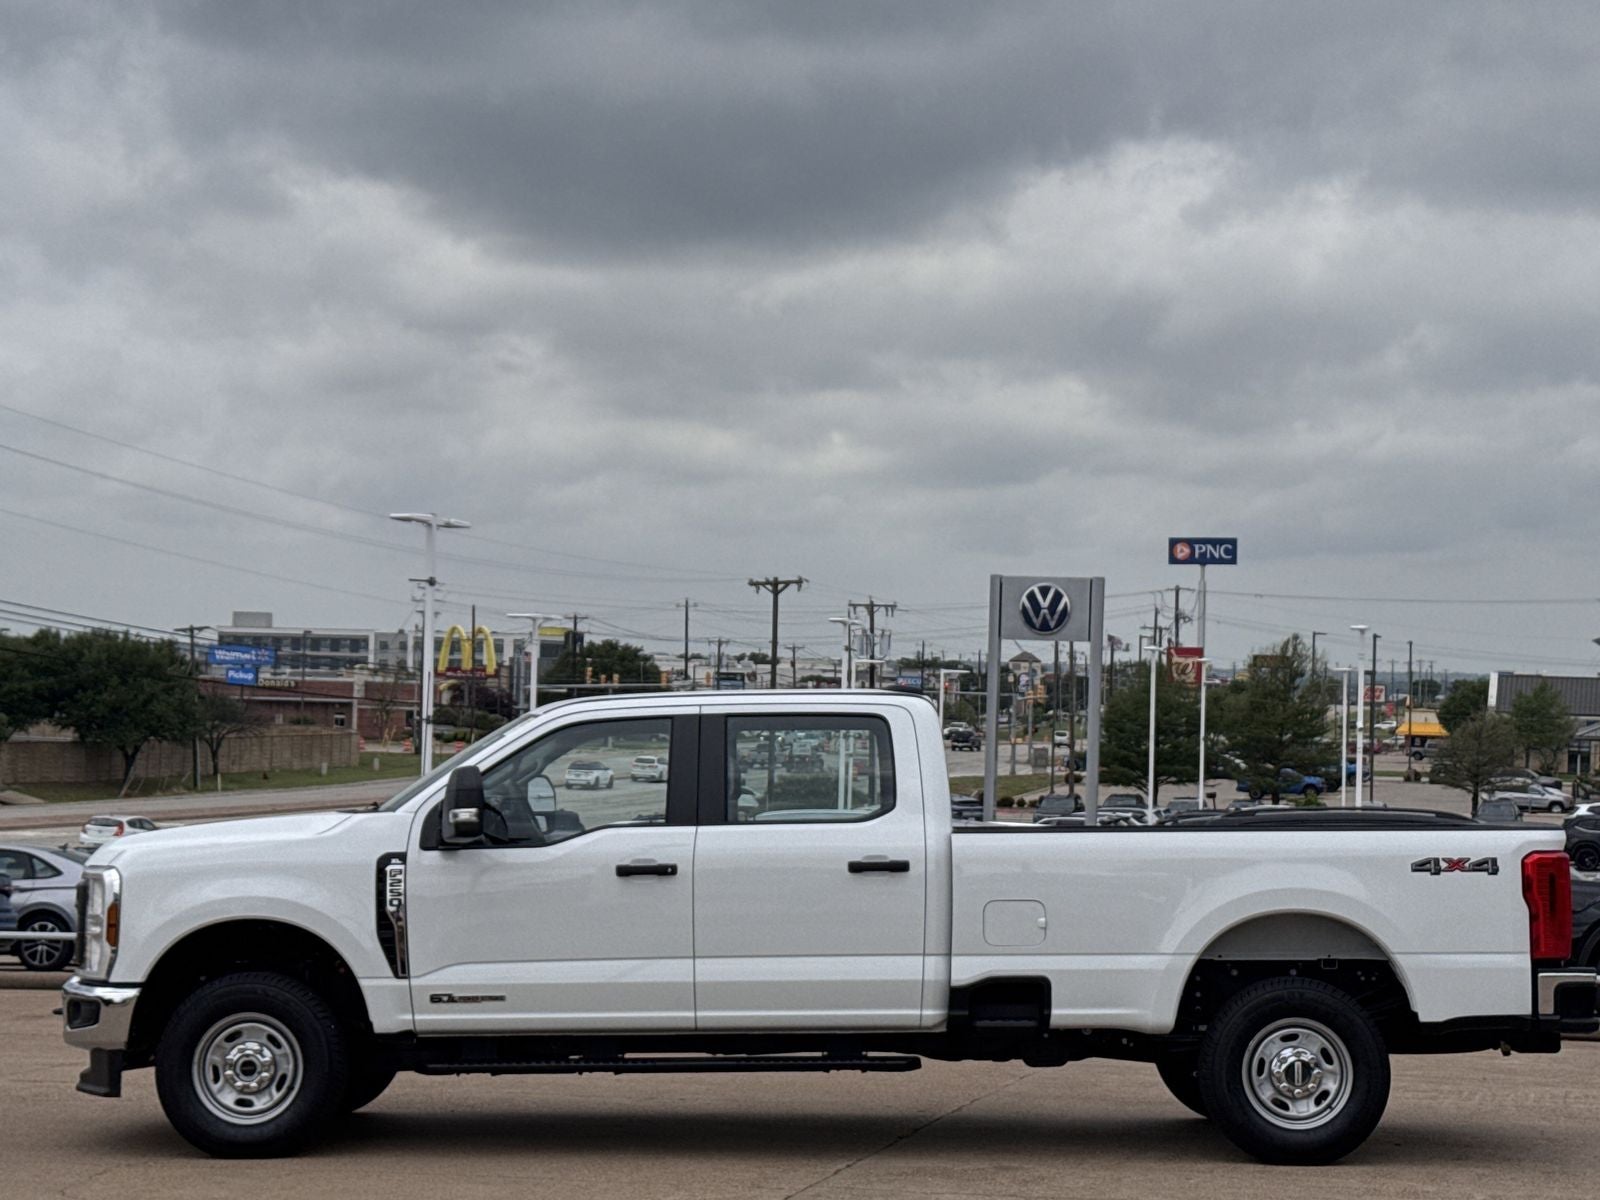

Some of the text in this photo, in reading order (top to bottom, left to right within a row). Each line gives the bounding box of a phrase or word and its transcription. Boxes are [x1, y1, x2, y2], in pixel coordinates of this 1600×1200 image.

[1193, 543, 1233, 559] PNC
[214, 648, 257, 661] Walmart
[227, 669, 255, 681] Pickup
[257, 679, 296, 688] Donald's
[389, 868, 403, 909] F250
